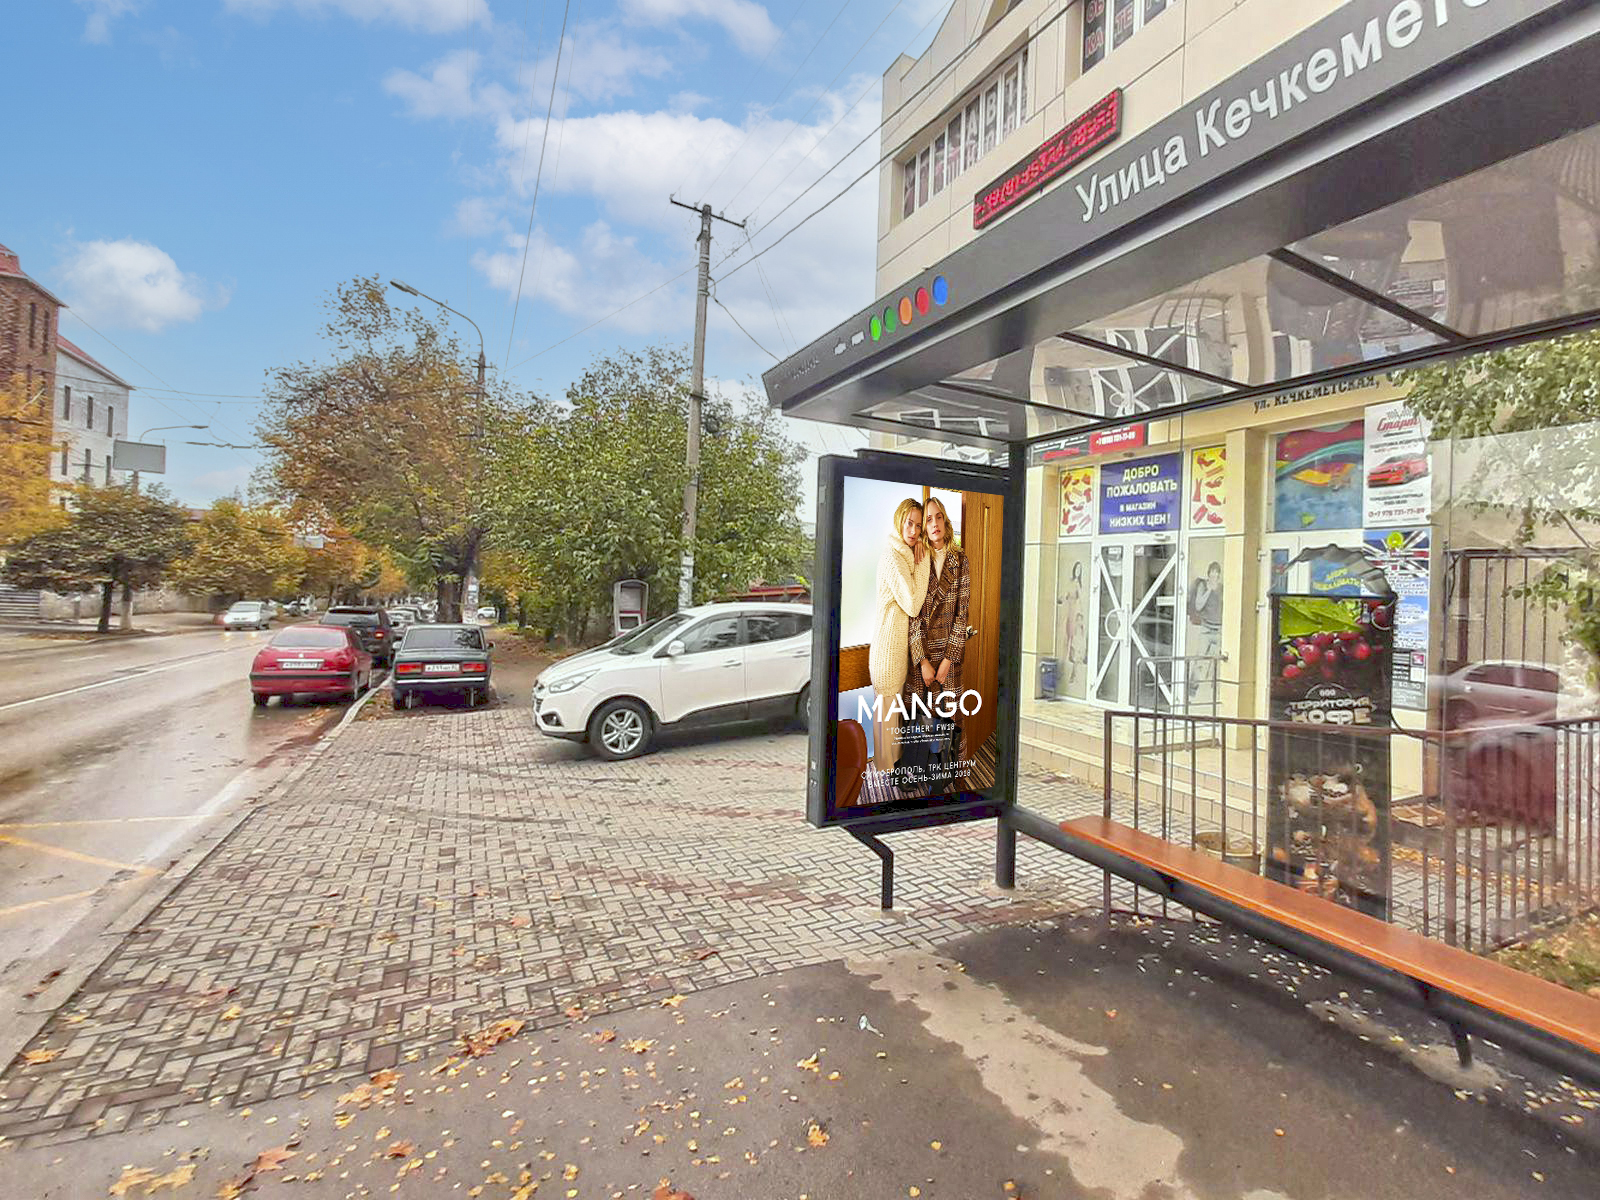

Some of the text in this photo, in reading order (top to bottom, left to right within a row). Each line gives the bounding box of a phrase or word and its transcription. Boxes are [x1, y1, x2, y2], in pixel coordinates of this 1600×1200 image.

[1076, 136, 1189, 222] Улица
[1254, 400, 1271, 413] ул.
[1122, 465, 1159, 481] ДОБРО
[1106, 479, 1178, 498] ПОЖАЛОВАТЬ
[1126, 501, 1156, 512] МАГАЗИН
[1109, 514, 1145, 528] НИЗКИХ
[857, 689, 982, 723] MANGO
[1289, 696, 1371, 709] ТЕРРИТОРИЯ
[936, 723, 955, 731] FW18
[928, 763, 941, 772] ТРК
[943, 760, 976, 769] ЦЕНТРУМ
[868, 769, 971, 789] ВМЕСТЕ ОСЕНЬ-ЗИМА 2018
